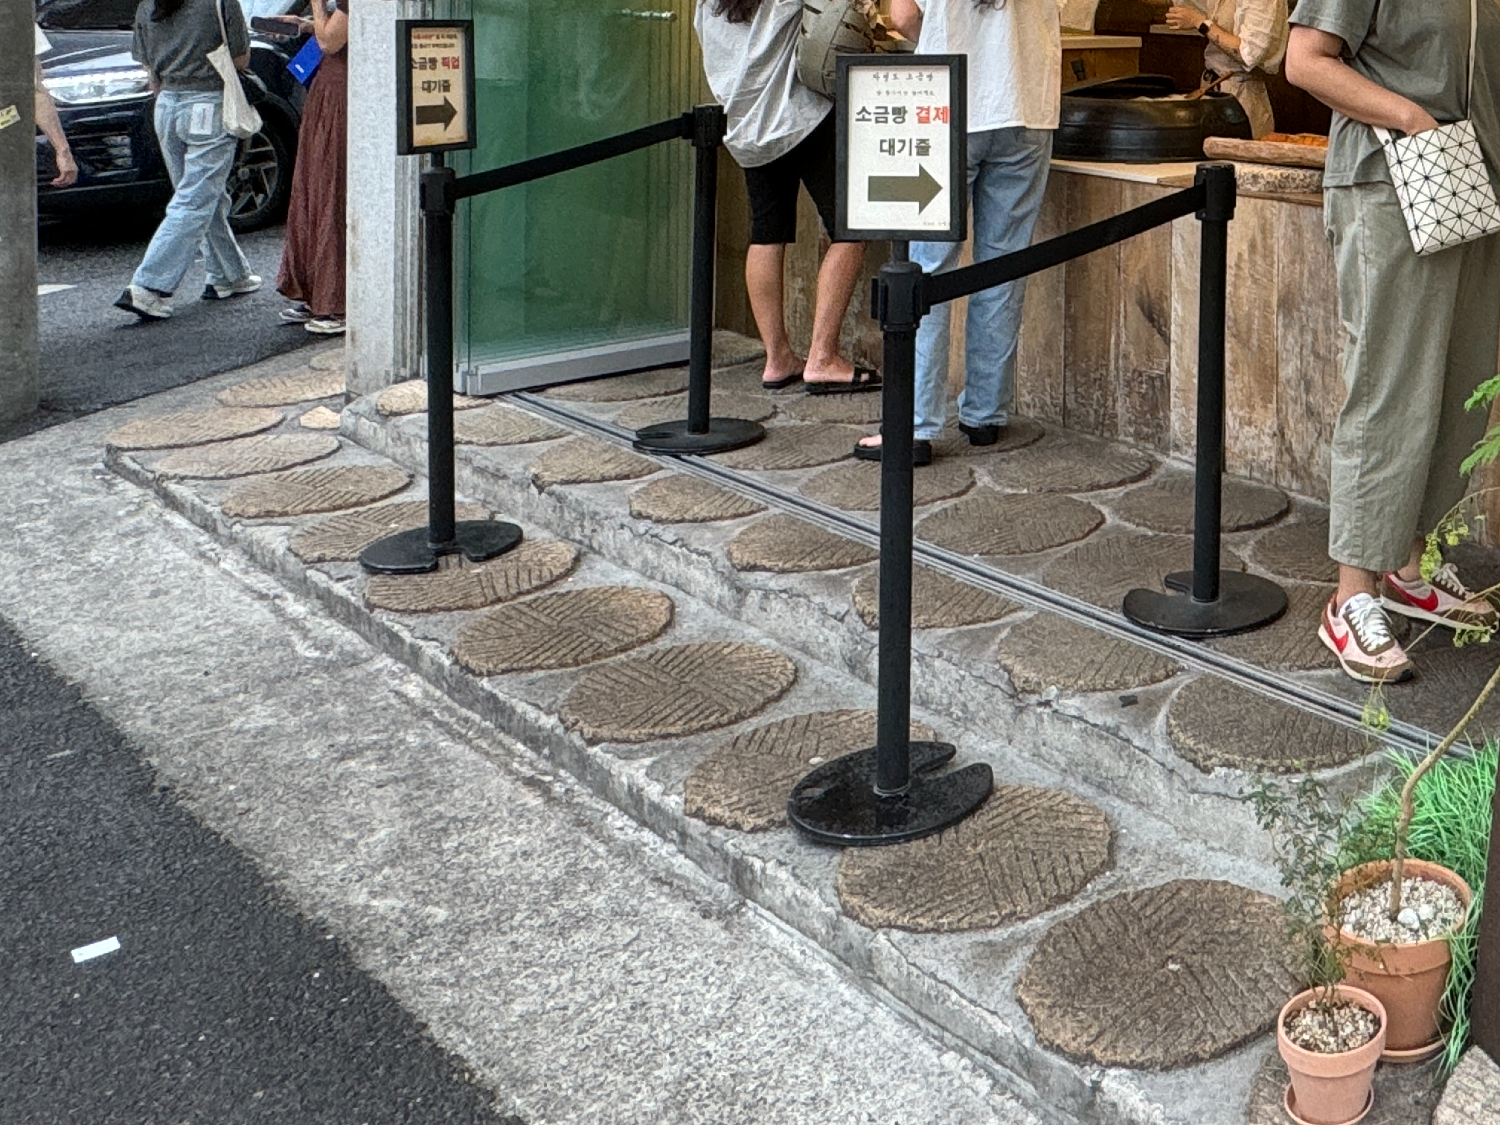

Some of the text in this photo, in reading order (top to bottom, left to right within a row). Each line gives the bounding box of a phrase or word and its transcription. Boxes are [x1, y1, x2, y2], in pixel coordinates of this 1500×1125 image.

[855, 105, 950, 124] 소금빵 결제
[879, 138, 932, 157] 대기줄
